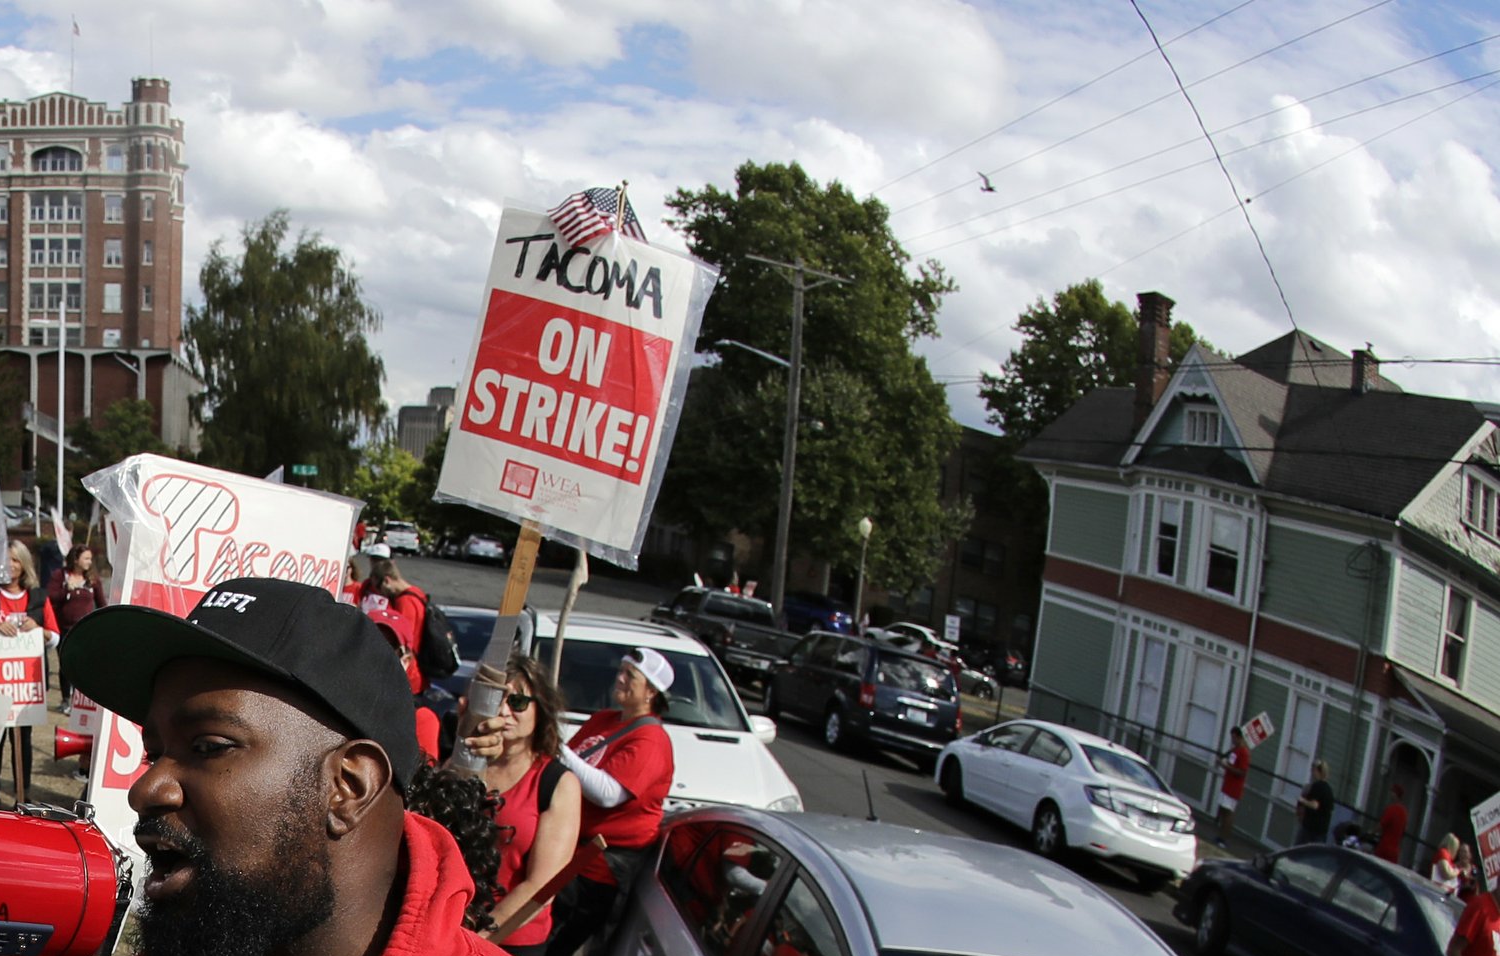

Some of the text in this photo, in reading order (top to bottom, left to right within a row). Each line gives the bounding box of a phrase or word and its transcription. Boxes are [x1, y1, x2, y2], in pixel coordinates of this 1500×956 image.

[505, 232, 664, 319] TACOMA
[537, 317, 611, 388] ON
[467, 367, 651, 474] STRIKE!
[541, 471, 582, 497] WEA
[2, 660, 25, 681] ON
